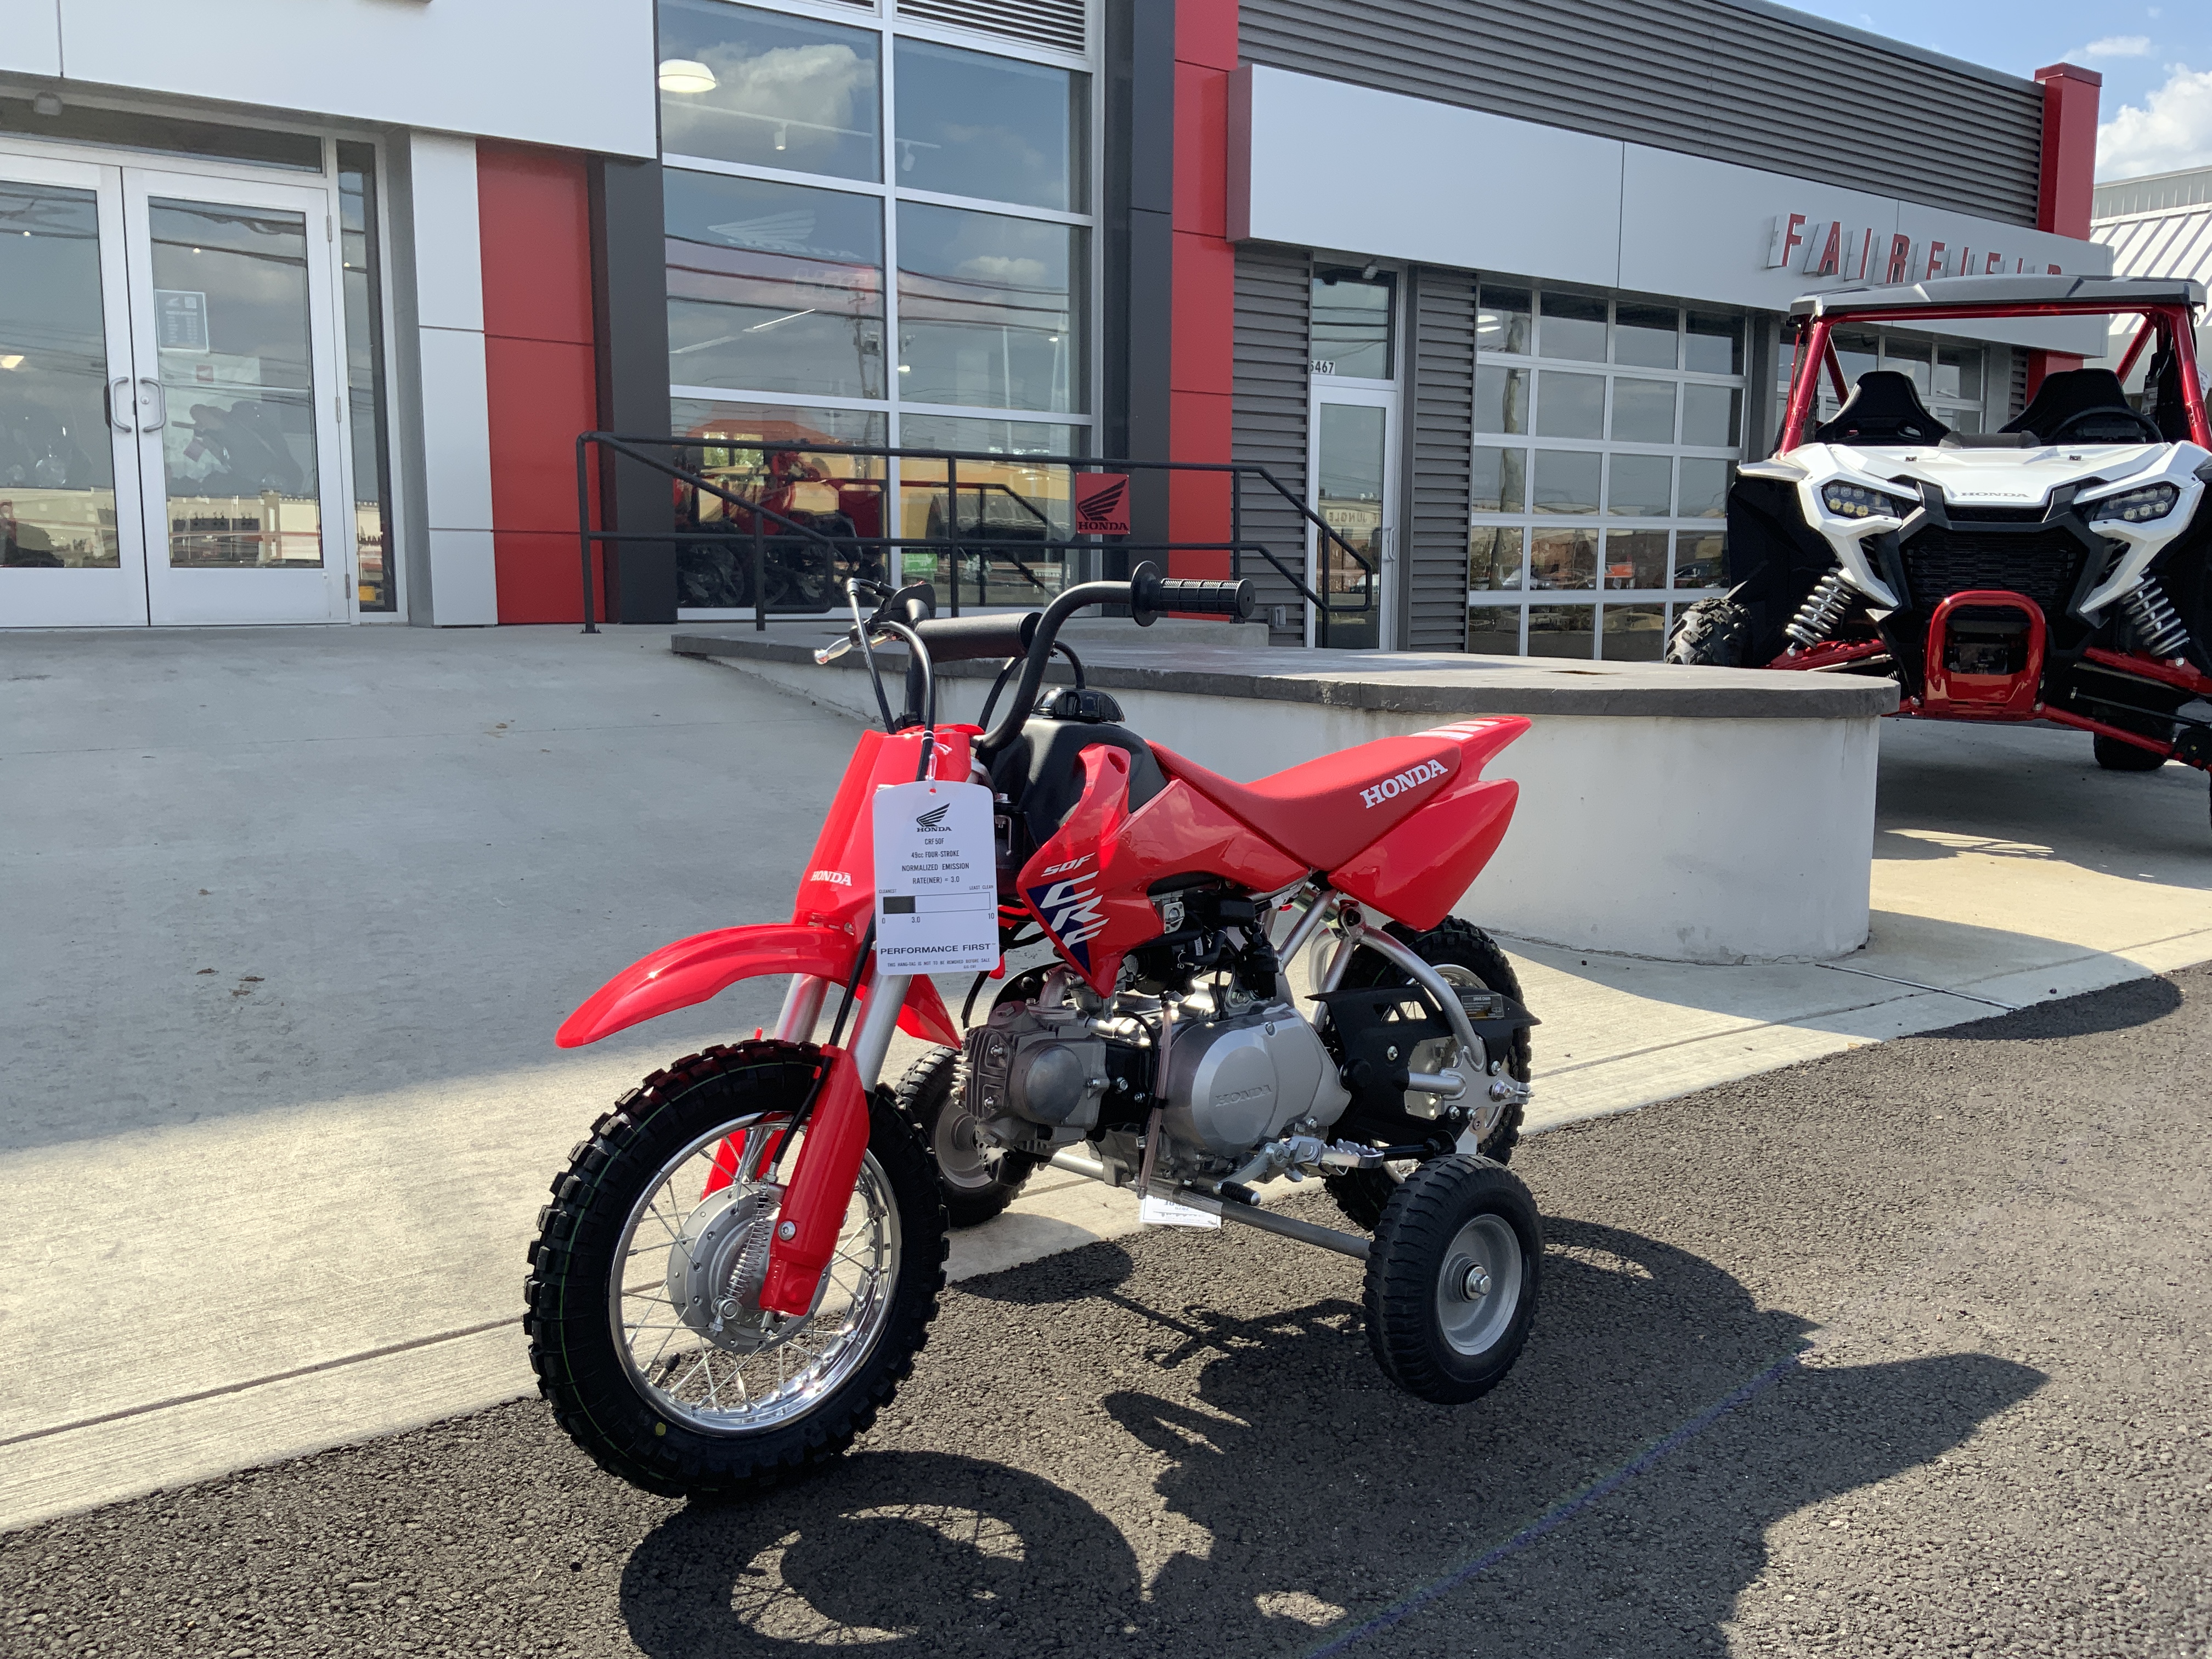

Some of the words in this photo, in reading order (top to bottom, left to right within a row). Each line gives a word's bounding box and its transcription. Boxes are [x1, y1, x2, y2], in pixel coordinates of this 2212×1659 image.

[1078, 522, 1129, 531] HONDA
[1360, 759, 1448, 809] HONDA
[1041, 852, 1096, 877] 50F
[810, 870, 852, 887] HONDA
[1040, 871, 1110, 950] CRF
[881, 945, 958, 955] PERFORMANCE
[1215, 1084, 1273, 1107] HONDA
